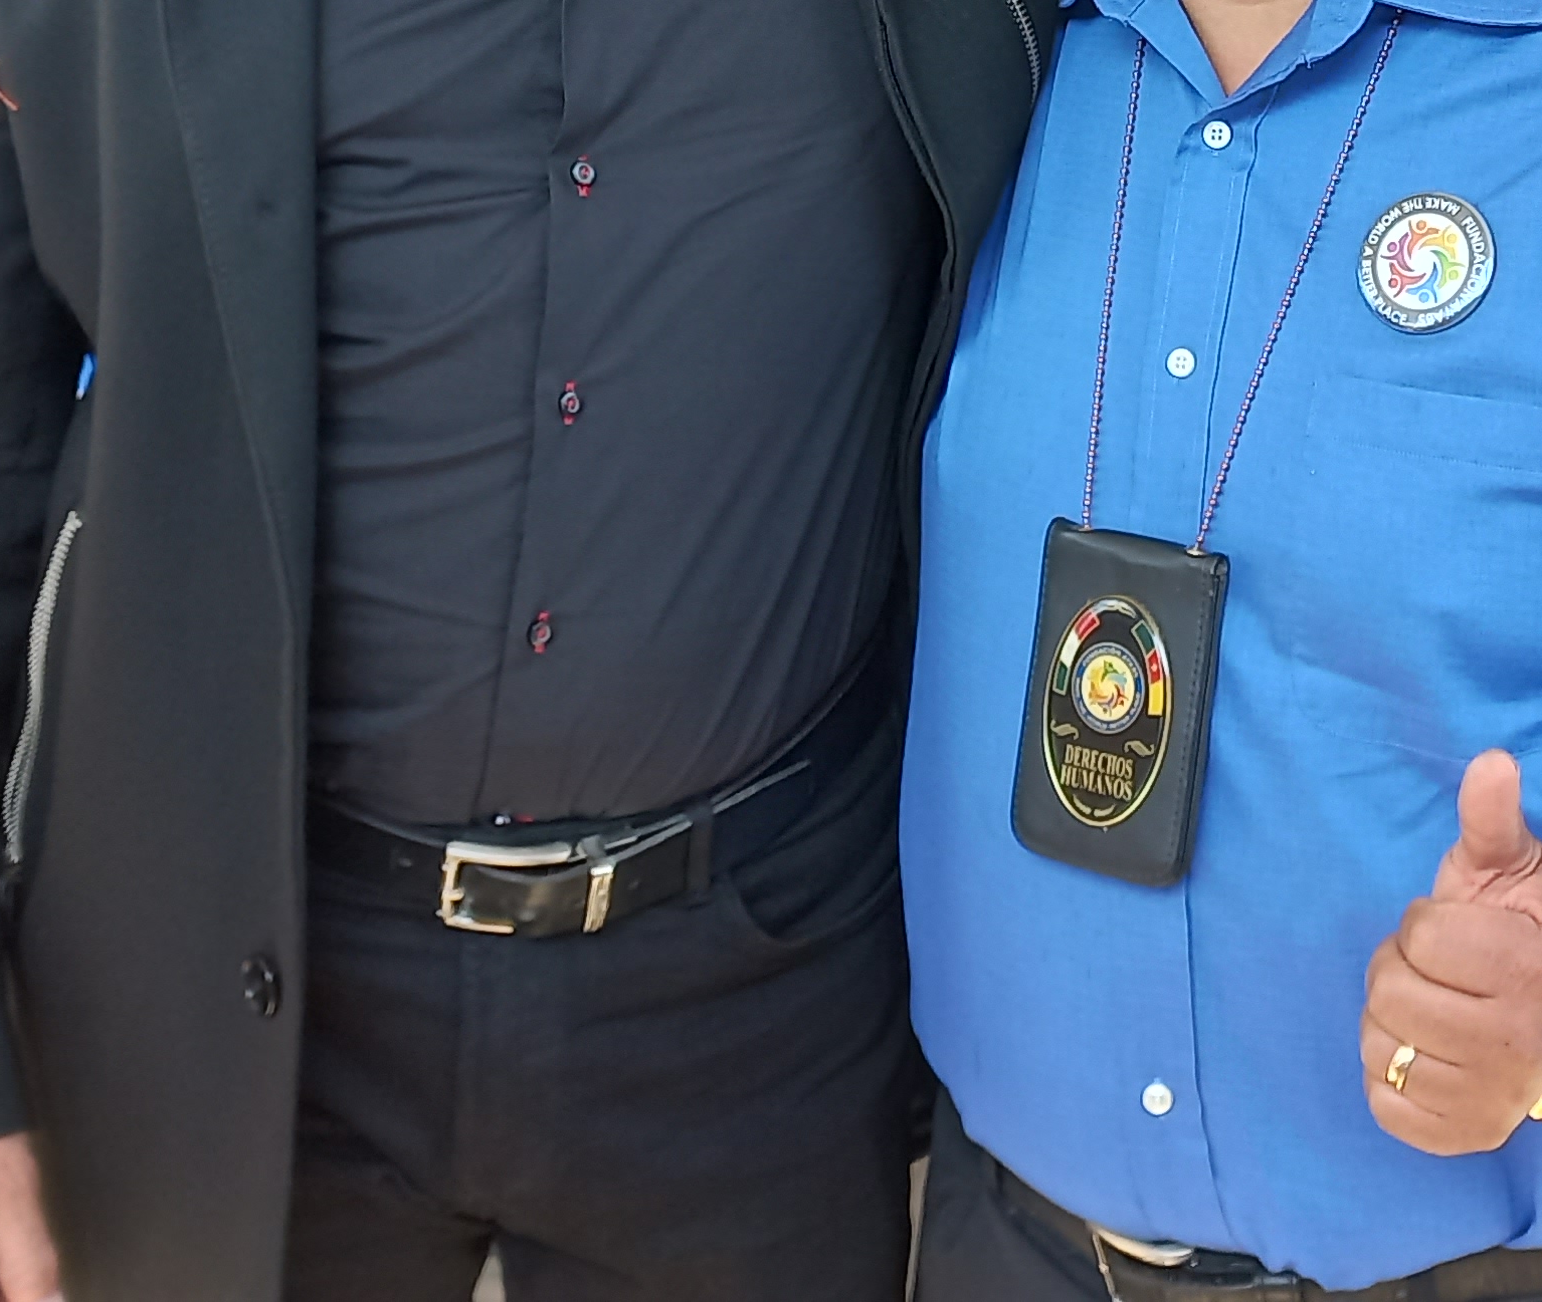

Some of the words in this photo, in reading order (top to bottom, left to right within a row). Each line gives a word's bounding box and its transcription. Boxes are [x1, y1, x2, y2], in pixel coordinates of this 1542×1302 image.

[1401, 198, 1424, 213] THE
[1425, 197, 1460, 215] MAKE
[1367, 210, 1402, 245] WORLD
[1363, 247, 1373, 257] A
[1361, 259, 1378, 298] BETTER
[1374, 298, 1408, 325] PLACE
[1064, 743, 1134, 781] DERECHOS
[1060, 763, 1133, 802] HUMANOS
